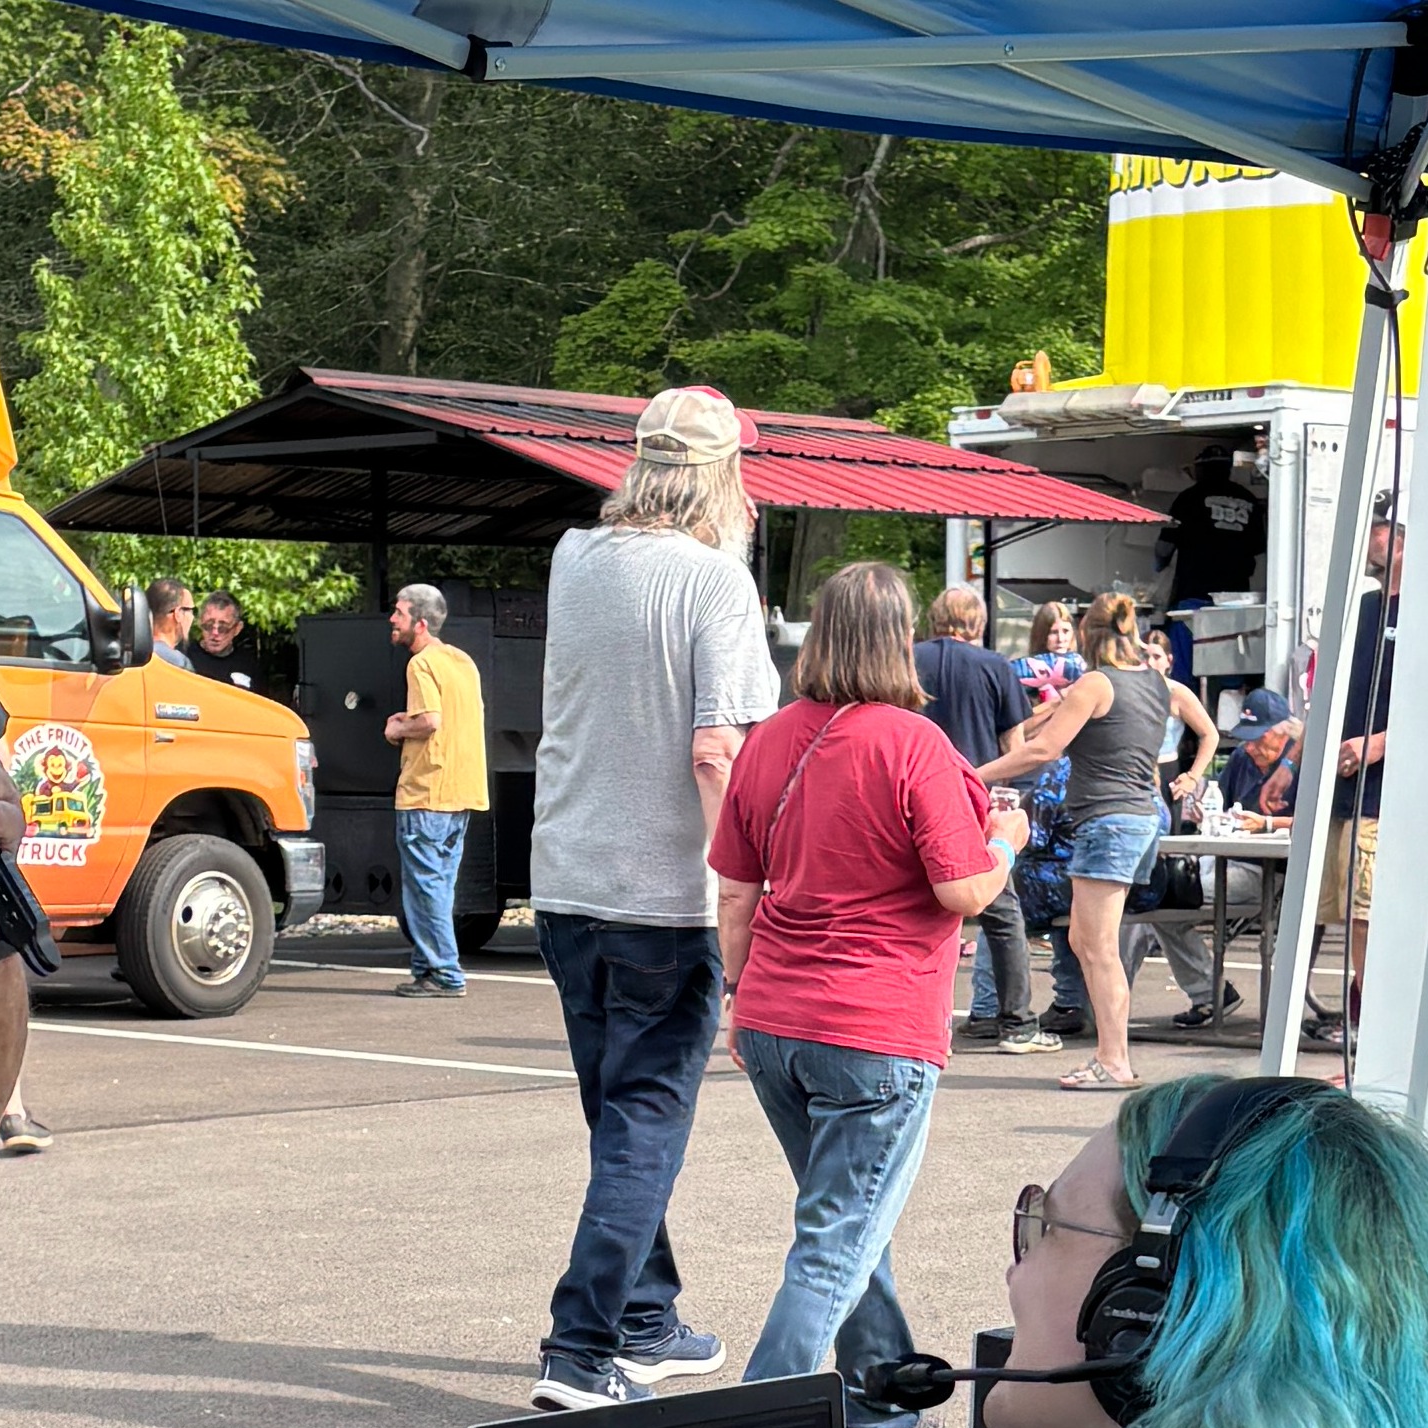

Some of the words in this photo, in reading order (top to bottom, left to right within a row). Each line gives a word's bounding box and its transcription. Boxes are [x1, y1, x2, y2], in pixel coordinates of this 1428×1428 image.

[18, 732, 43, 752] THE
[47, 728, 88, 752] FRUIT
[20, 843, 83, 862] TRUCK
